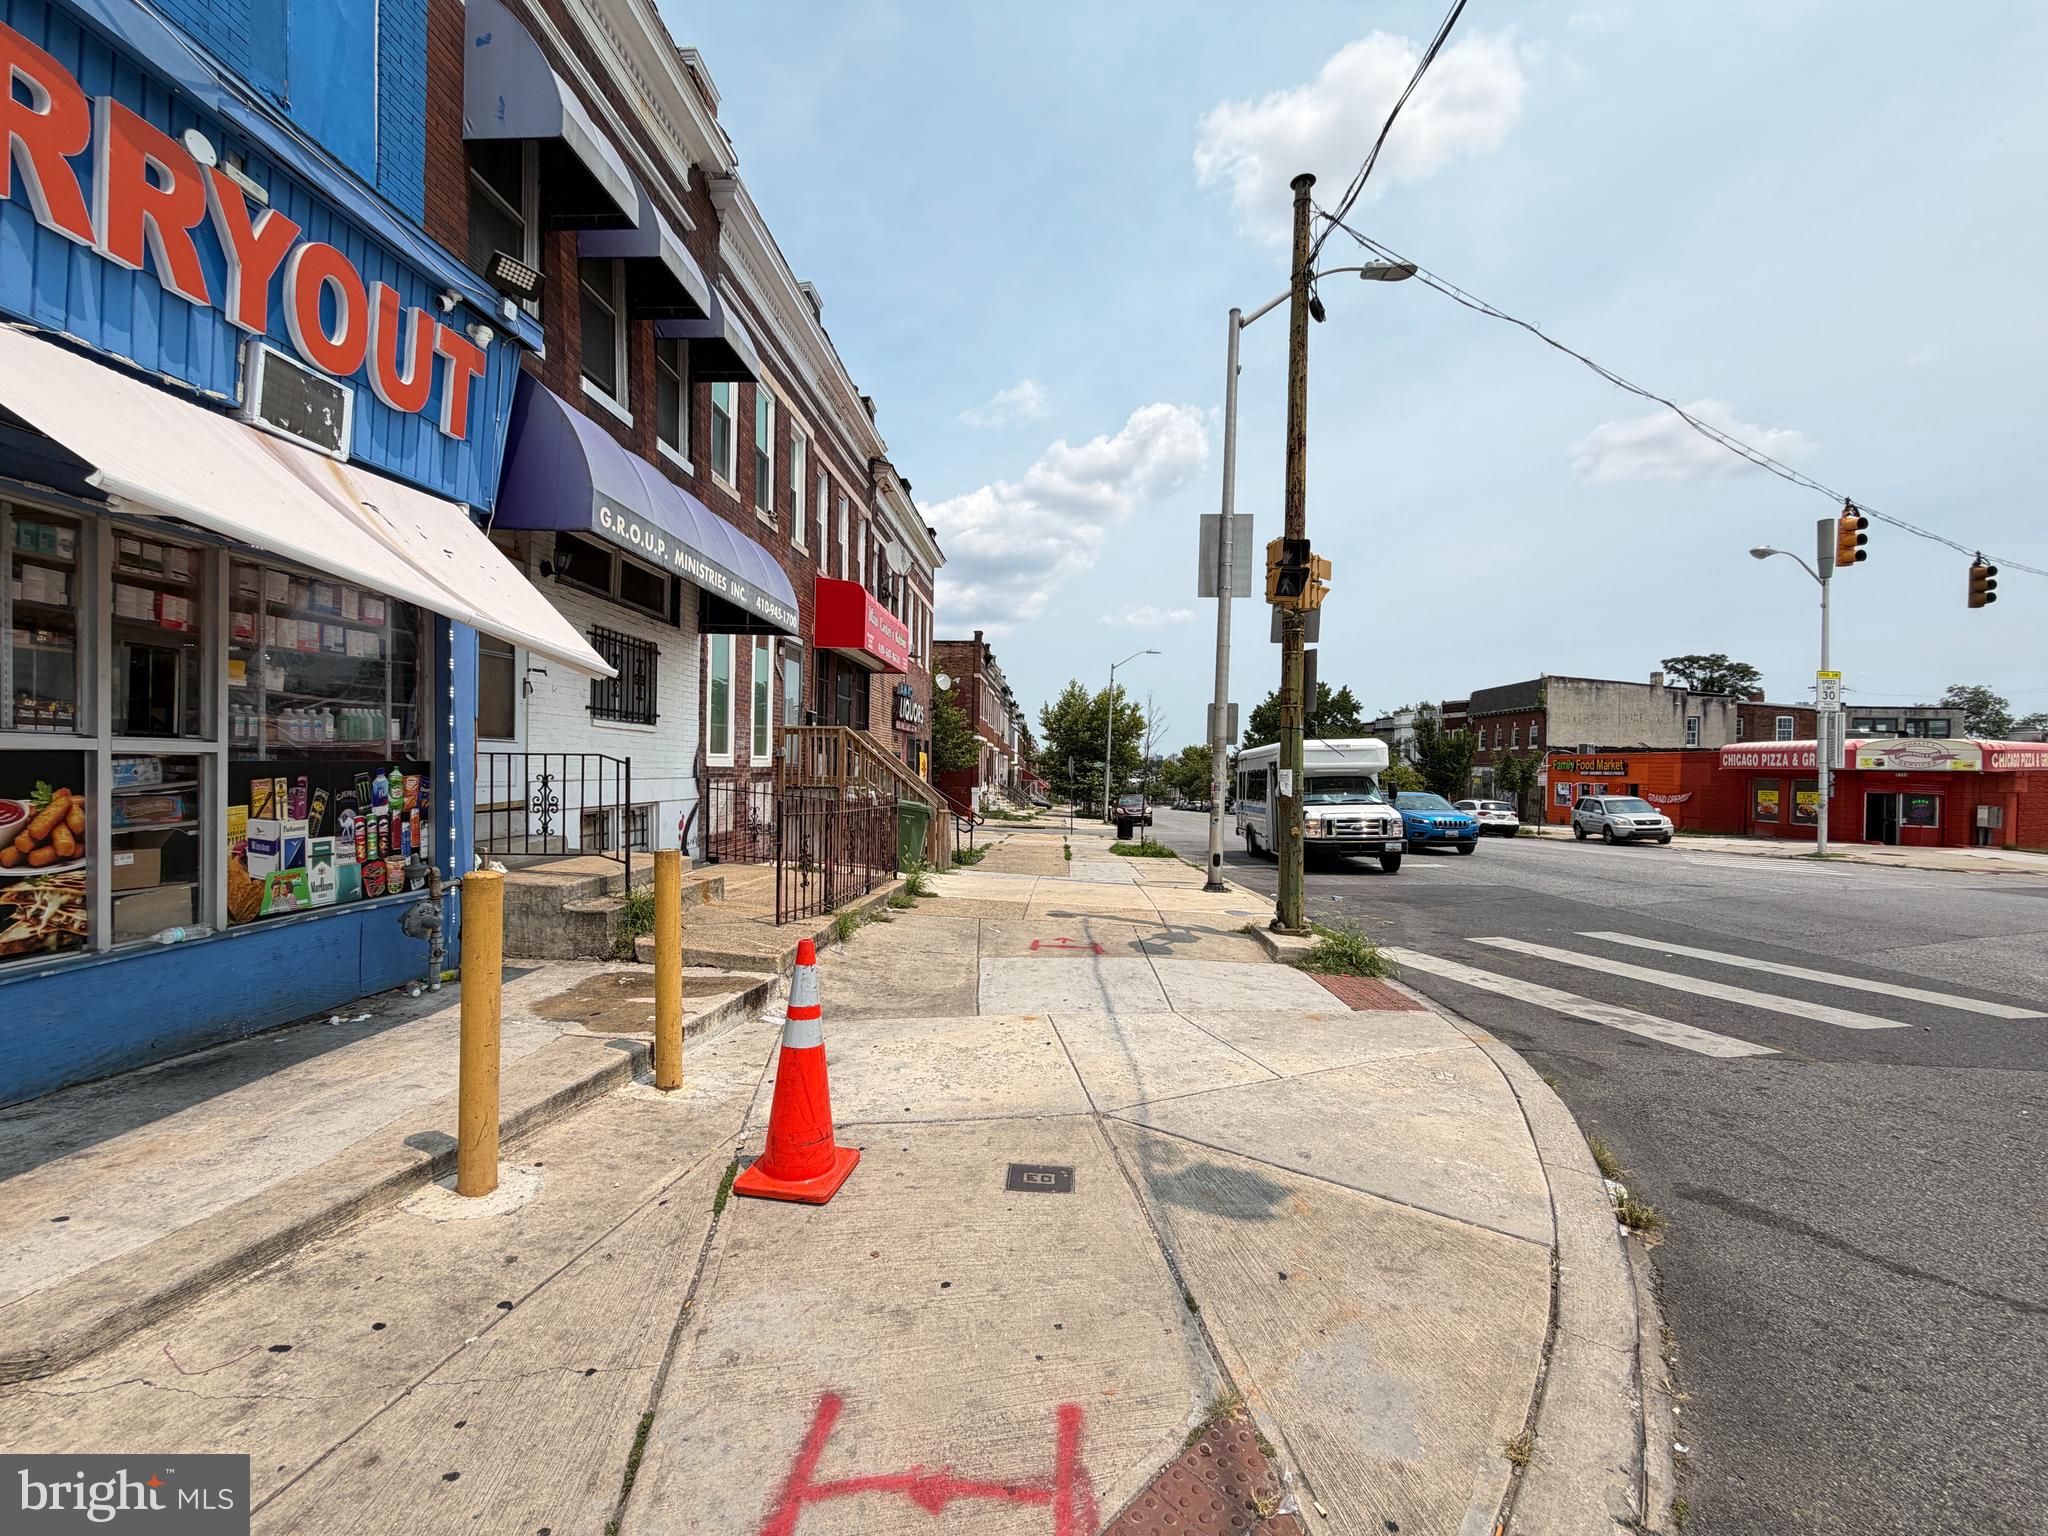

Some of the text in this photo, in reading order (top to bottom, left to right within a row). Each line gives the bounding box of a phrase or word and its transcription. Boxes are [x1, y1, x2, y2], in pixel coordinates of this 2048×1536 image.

[600, 506, 668, 560] G.R.O.U.P.
[674, 549, 727, 591] MINISTRIES
[756, 596, 797, 628] 410-945-1700
[1822, 691, 1836, 700] 30
[899, 697, 924, 725] LIQUORS
[1553, 759, 1624, 772] Family Food Market
[1722, 754, 1759, 767] CHICAGO
[1761, 753, 1789, 767] PIZZA
[1792, 753, 1799, 767] &
[1991, 752, 2020, 768] CHICAGO
[2021, 752, 2035, 768] PIZZA
[336, 790, 357, 802] CAME
[251, 842, 271, 852] Winston
[336, 851, 356, 860] Newpo
[310, 877, 334, 893] Marlboro
